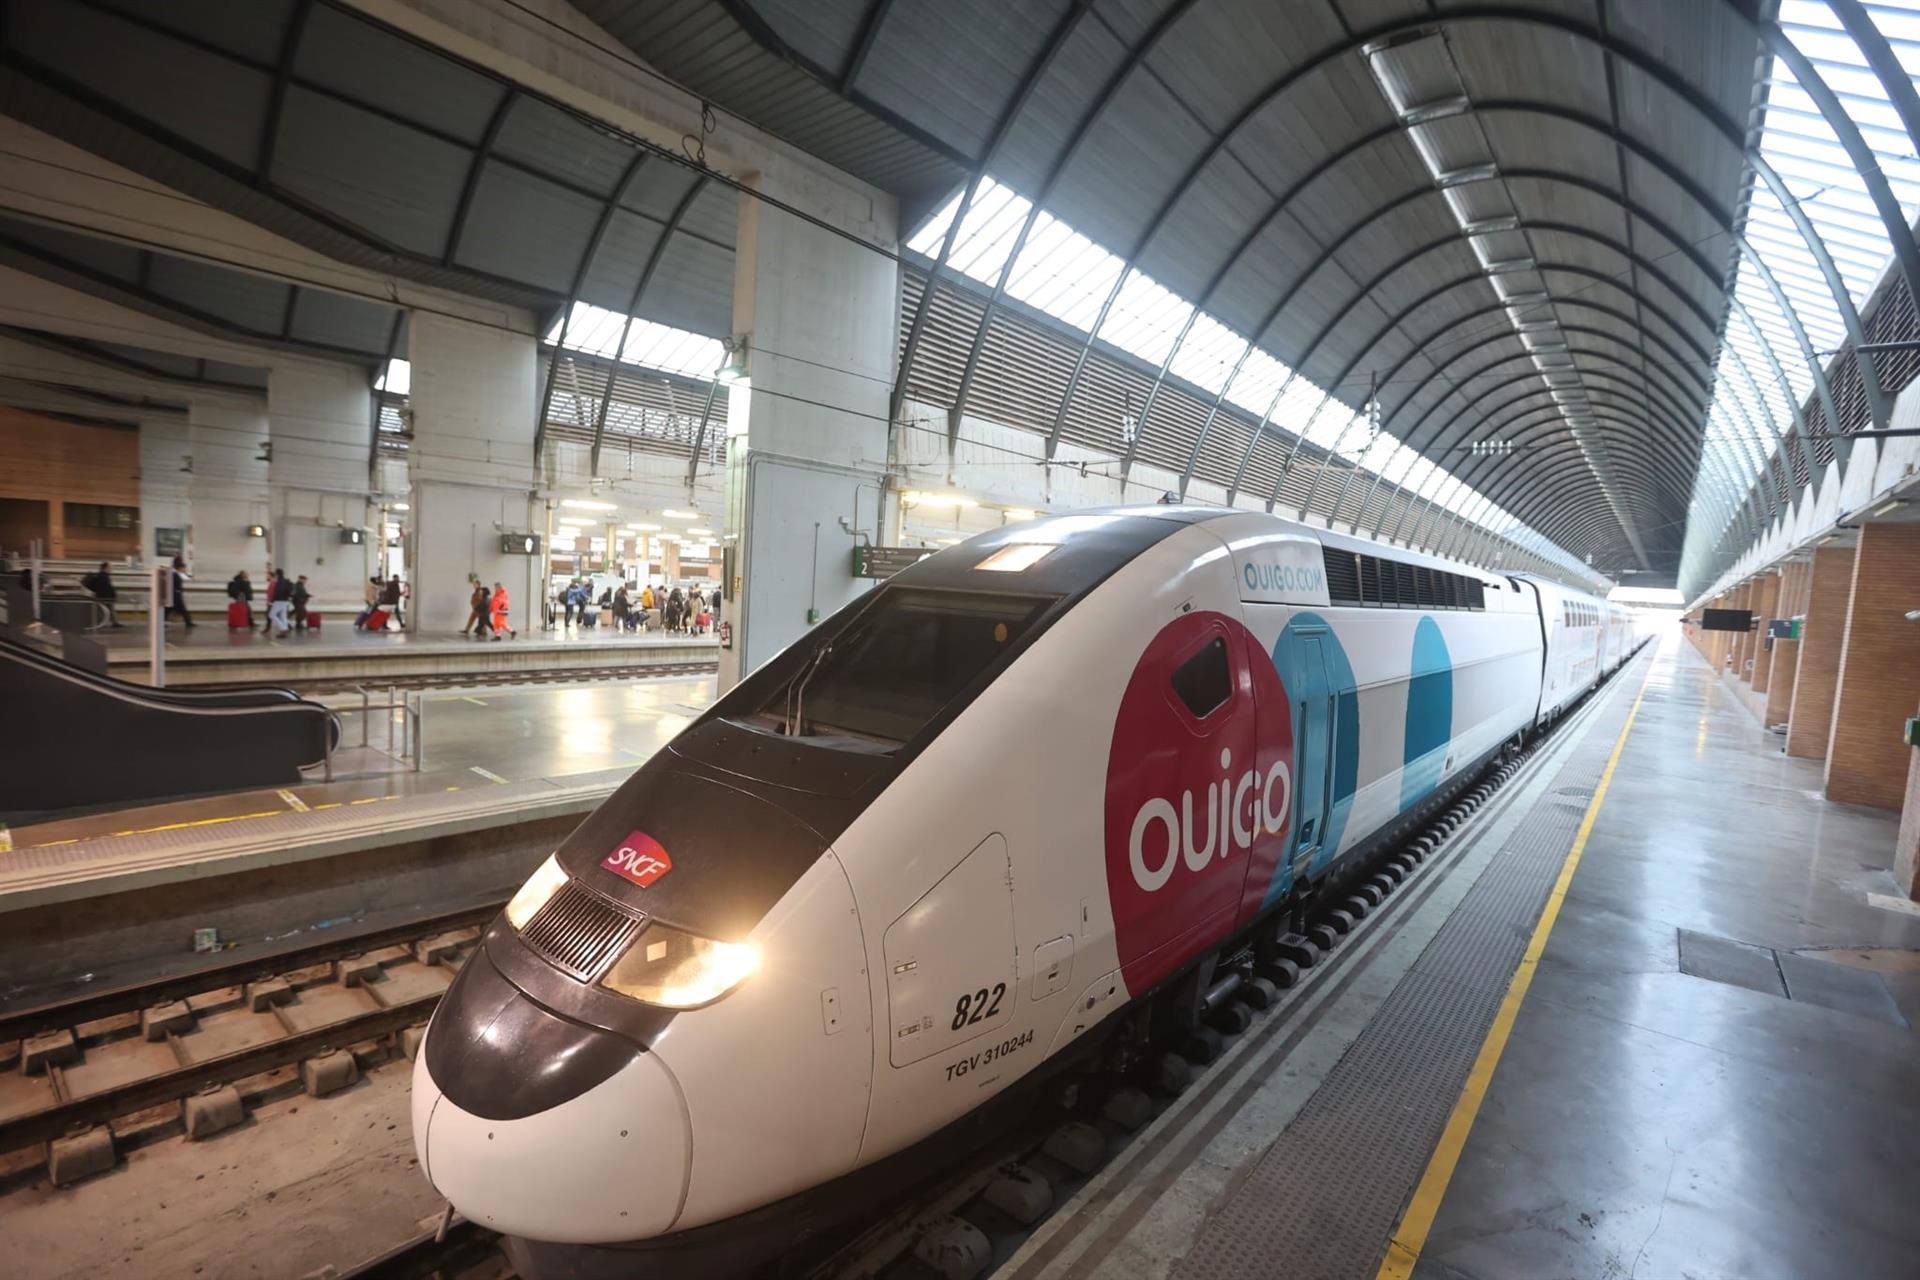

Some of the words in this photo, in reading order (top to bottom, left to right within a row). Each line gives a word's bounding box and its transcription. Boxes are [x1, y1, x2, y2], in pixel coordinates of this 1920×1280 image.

[861, 562, 868, 575] 2
[1244, 562, 1324, 592] OUIGO.COM
[607, 847, 667, 877] SNCF
[951, 982, 1006, 1031] 822
[946, 1053, 981, 1082] TGV
[983, 1029, 1034, 1065] 310244
